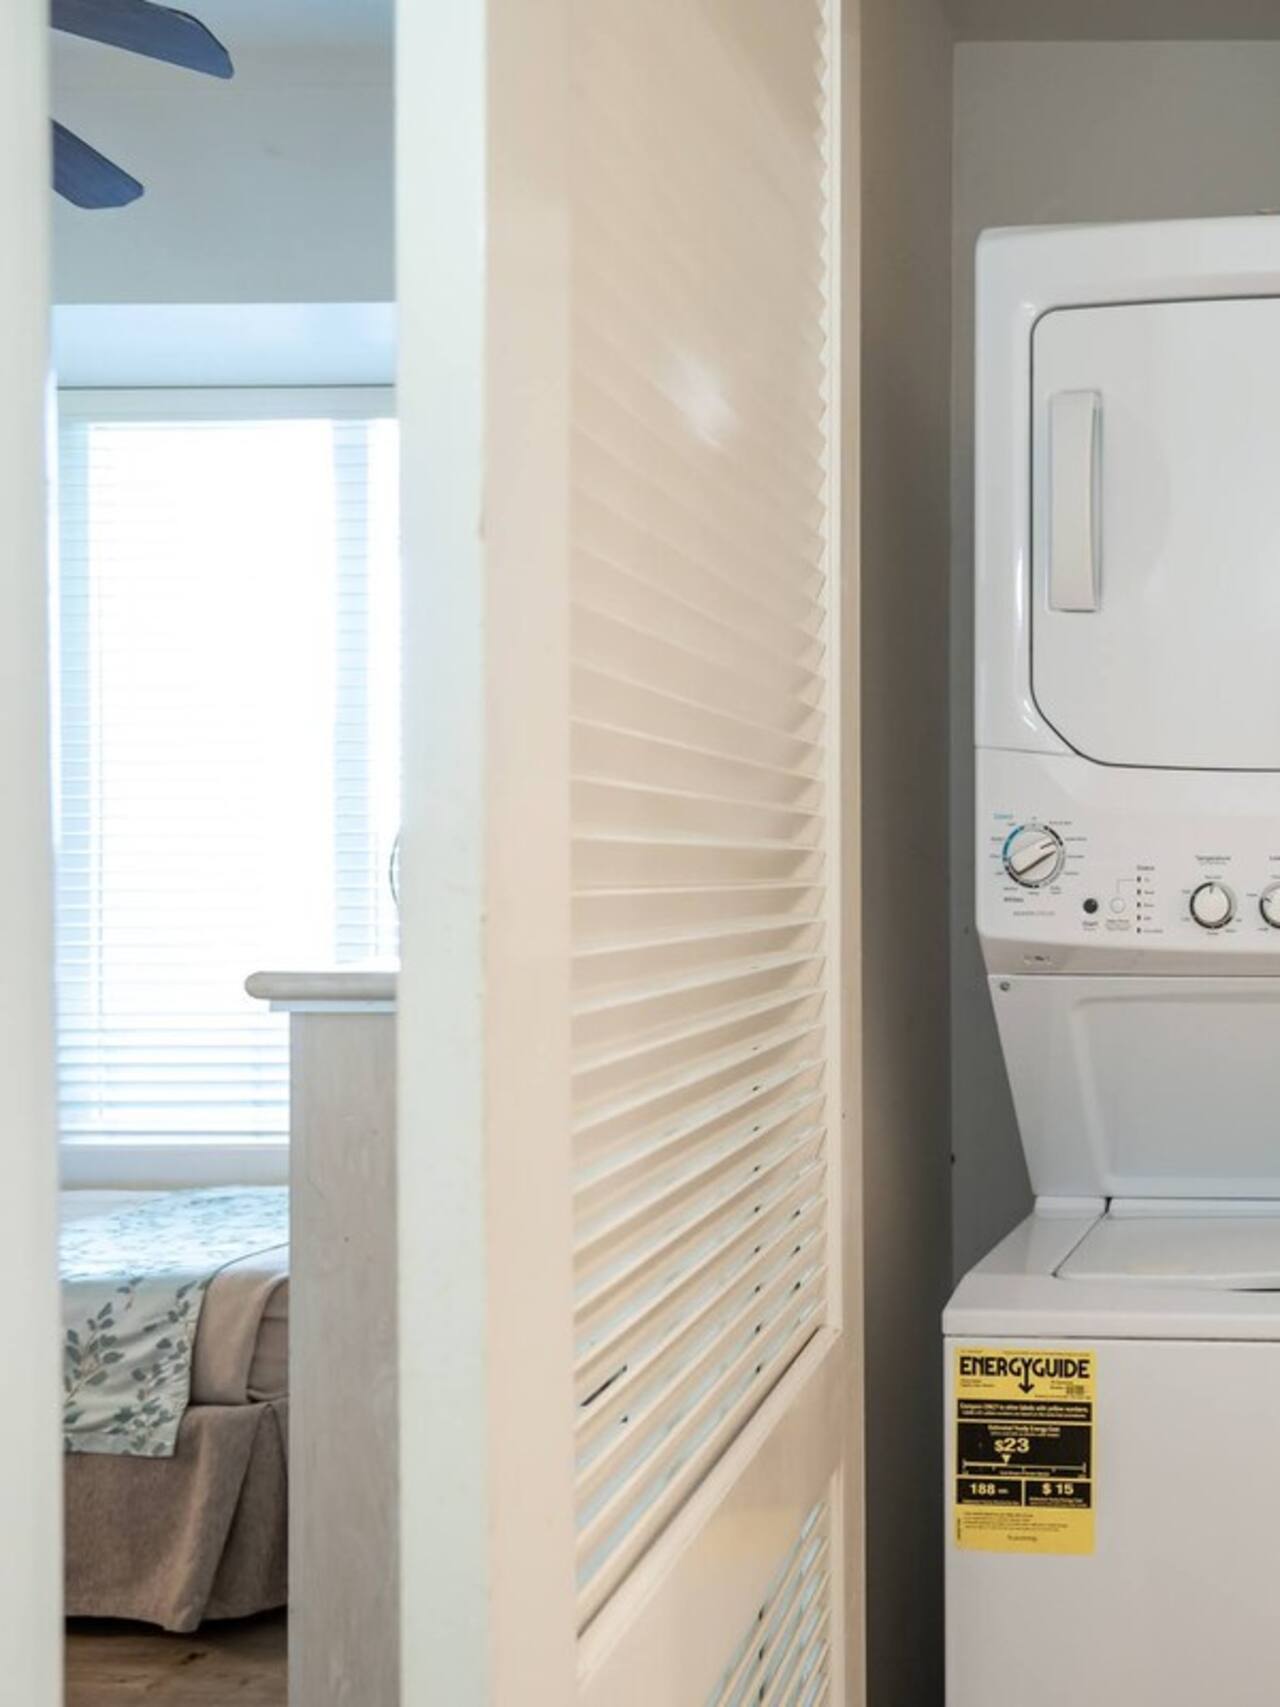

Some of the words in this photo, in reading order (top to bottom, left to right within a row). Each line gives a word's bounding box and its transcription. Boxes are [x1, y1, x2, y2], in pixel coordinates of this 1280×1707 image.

[960, 1356, 1090, 1382] ENERGYGUIDE
[994, 1438, 1030, 1453] $23
[970, 1483, 996, 1495] 188
[1042, 1482, 1052, 1496] $
[1056, 1483, 1074, 1496] 15
